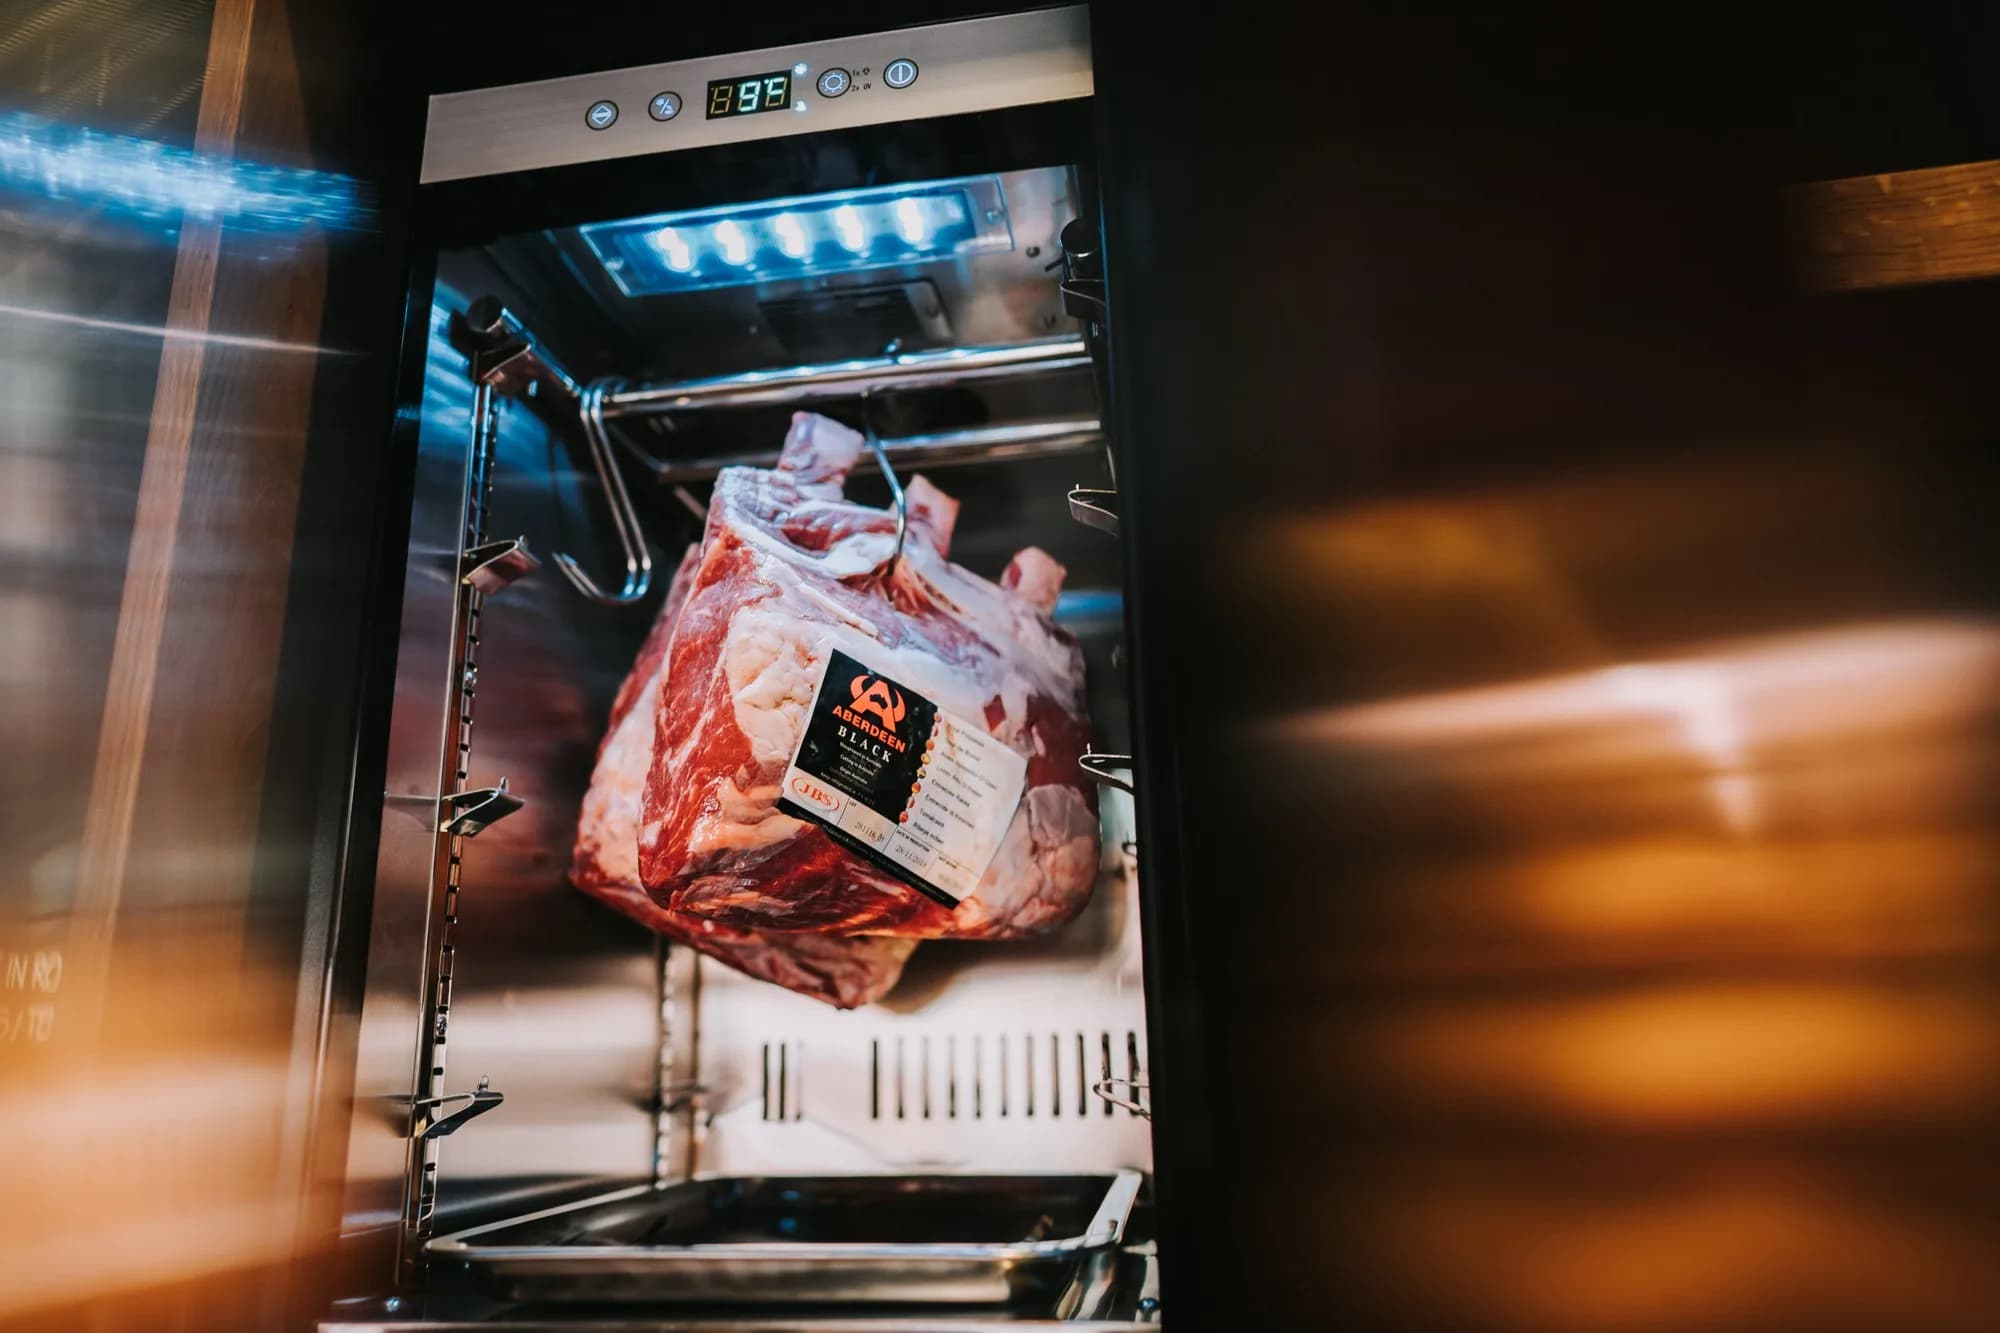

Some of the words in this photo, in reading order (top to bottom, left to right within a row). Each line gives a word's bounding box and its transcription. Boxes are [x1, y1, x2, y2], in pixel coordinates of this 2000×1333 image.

[832, 705, 906, 753] ABERDEEN
[838, 725, 892, 763] BLACK
[799, 783, 832, 807] JBS
